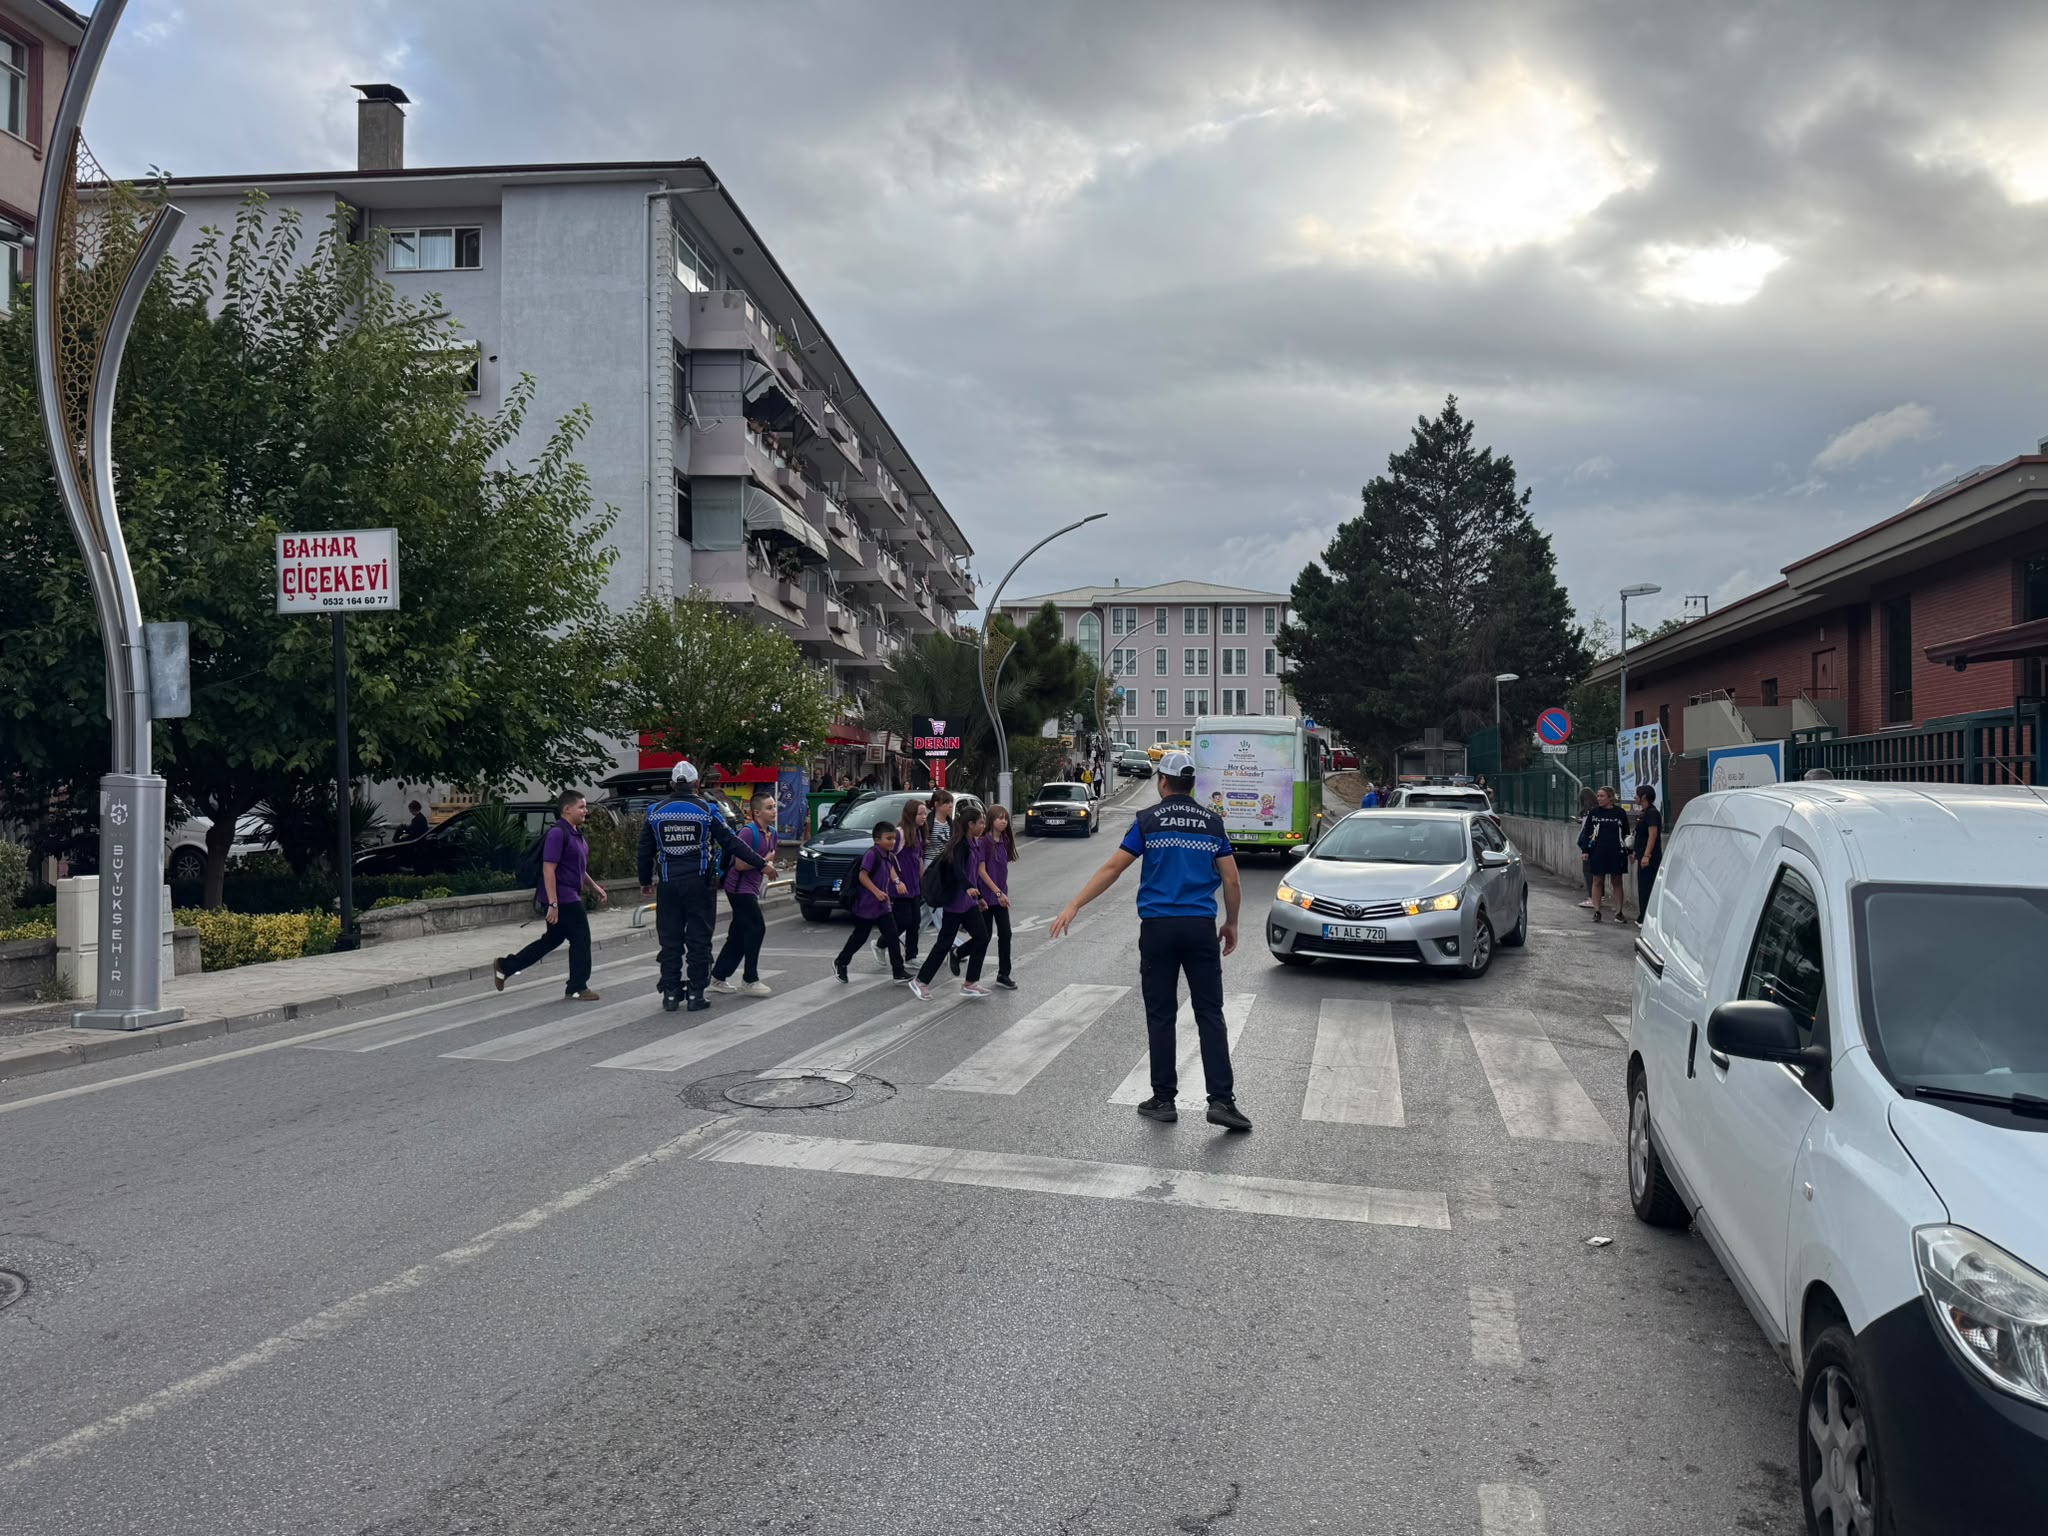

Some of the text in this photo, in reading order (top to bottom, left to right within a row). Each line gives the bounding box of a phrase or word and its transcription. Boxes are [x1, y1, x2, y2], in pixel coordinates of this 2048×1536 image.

[283, 536, 358, 558] BAHAR
[283, 558, 388, 601] ÇİÇEKEVİ
[323, 596, 388, 605] 0532 164 60 77
[1153, 804, 1211, 820] BÜYÜKŞEHİR
[1160, 817, 1207, 829] ZABITA
[665, 834, 696, 842] ZABITA
[1329, 926, 1384, 940] 41 ALE 720
